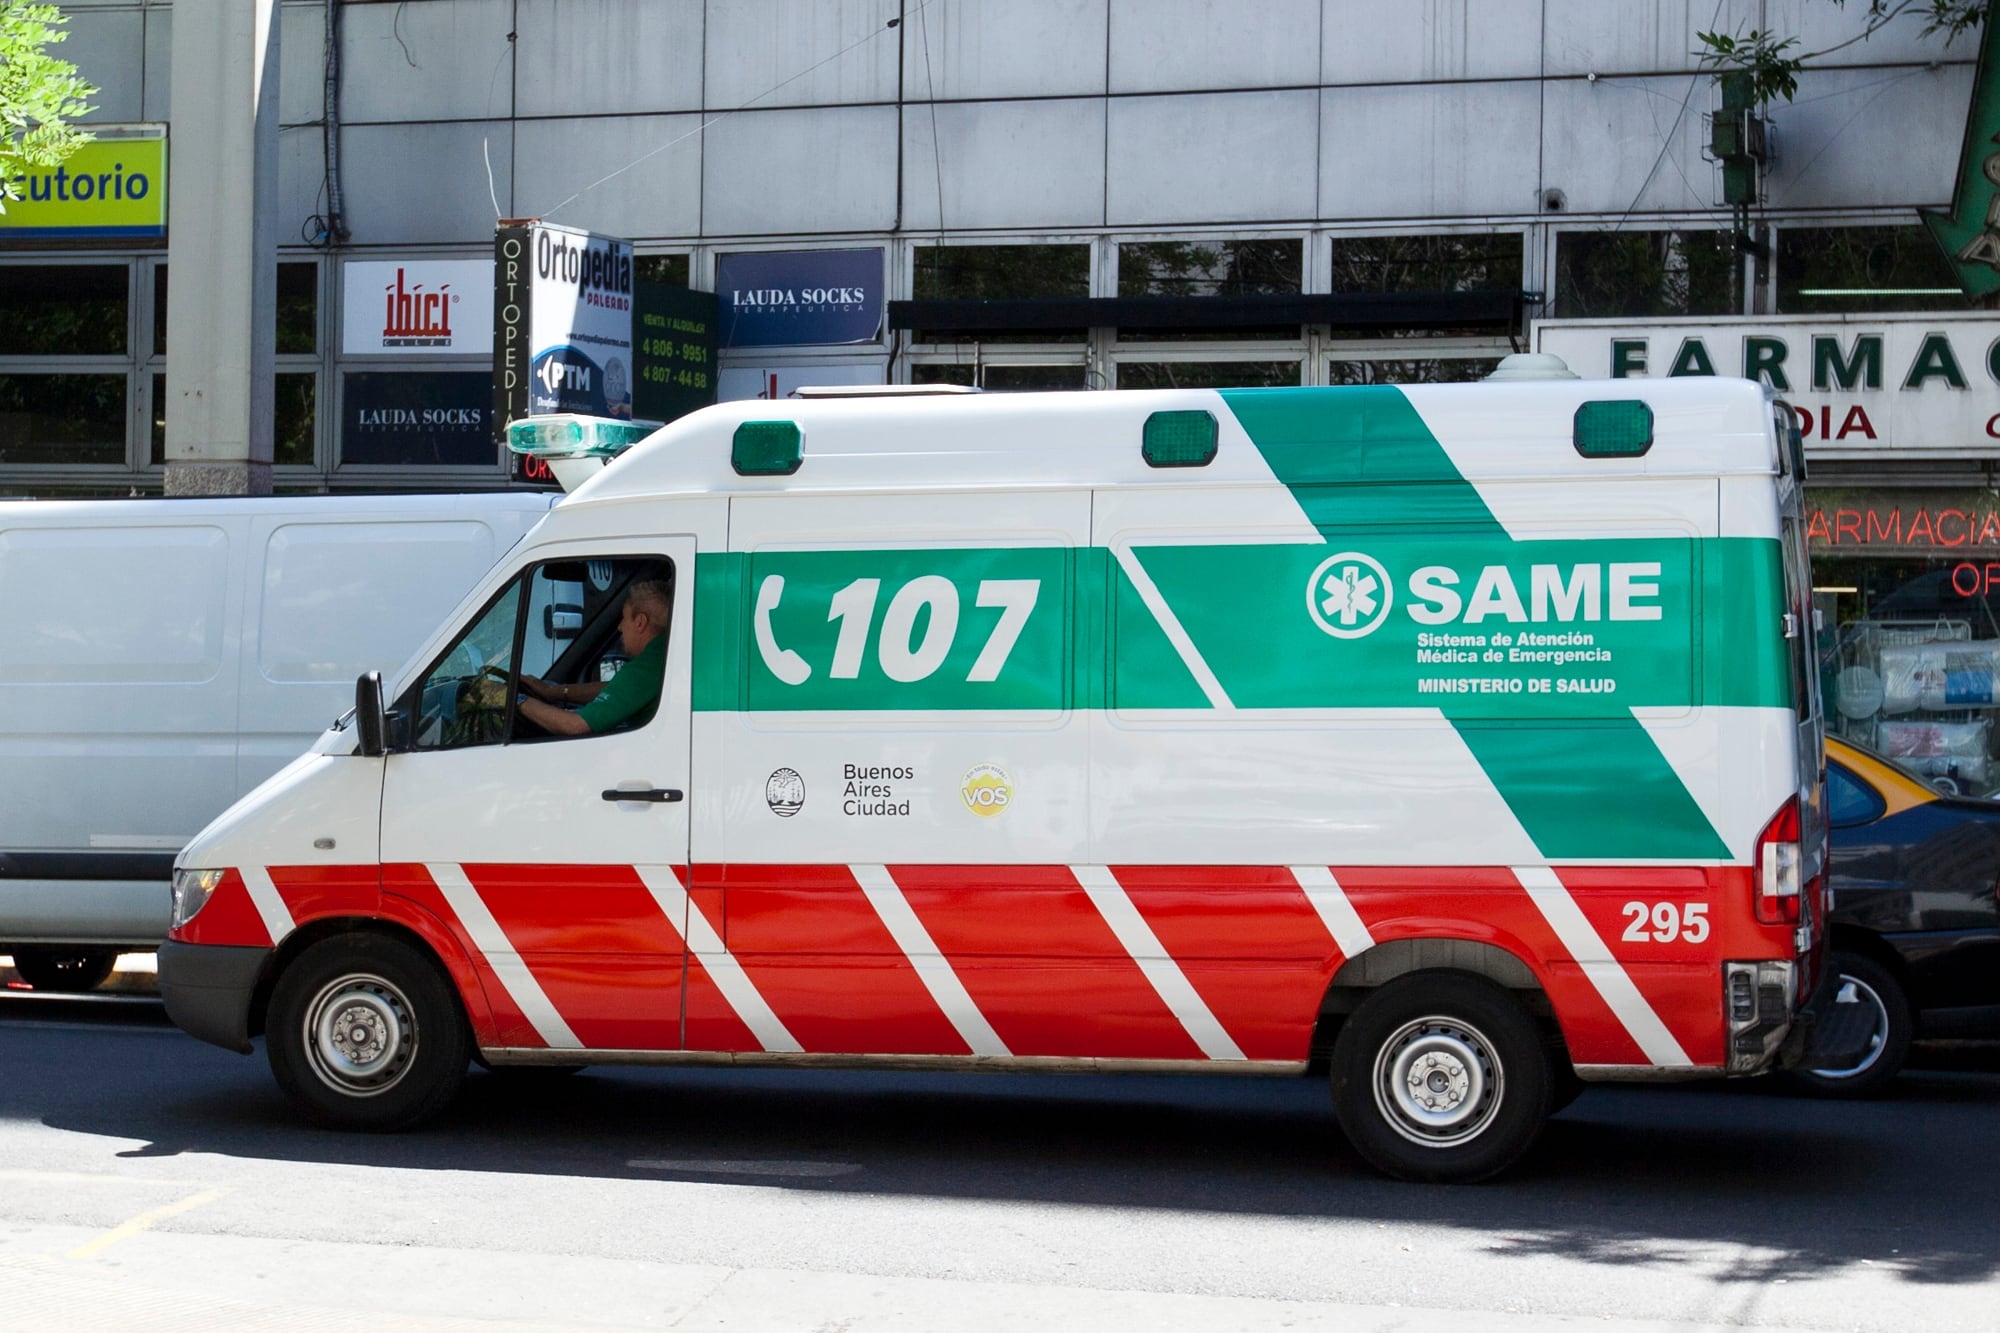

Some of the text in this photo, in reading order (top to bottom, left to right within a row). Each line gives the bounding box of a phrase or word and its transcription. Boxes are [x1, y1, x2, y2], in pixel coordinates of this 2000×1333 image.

[0, 163, 149, 202] cutorio
[538, 230, 631, 298] Ortopedia
[587, 292, 630, 312] PALERMO
[733, 287, 865, 306] LAUDA SOCKS
[551, 361, 591, 392] PTM
[359, 408, 481, 425] LAUDA SOCKS
[1406, 562, 1663, 625] SAME
[827, 575, 1041, 683] 107
[1417, 631, 1594, 647] Sistema de Atención
[1417, 648, 1612, 665] Médica de Emergencia
[1418, 678, 1616, 694] MINISTERIO DE SALUD
[844, 764, 914, 780] Buenos
[843, 781, 892, 798] Aires
[962, 786, 1009, 807] VOS
[843, 799, 910, 816] Ciudad
[1621, 901, 1710, 944] 295
